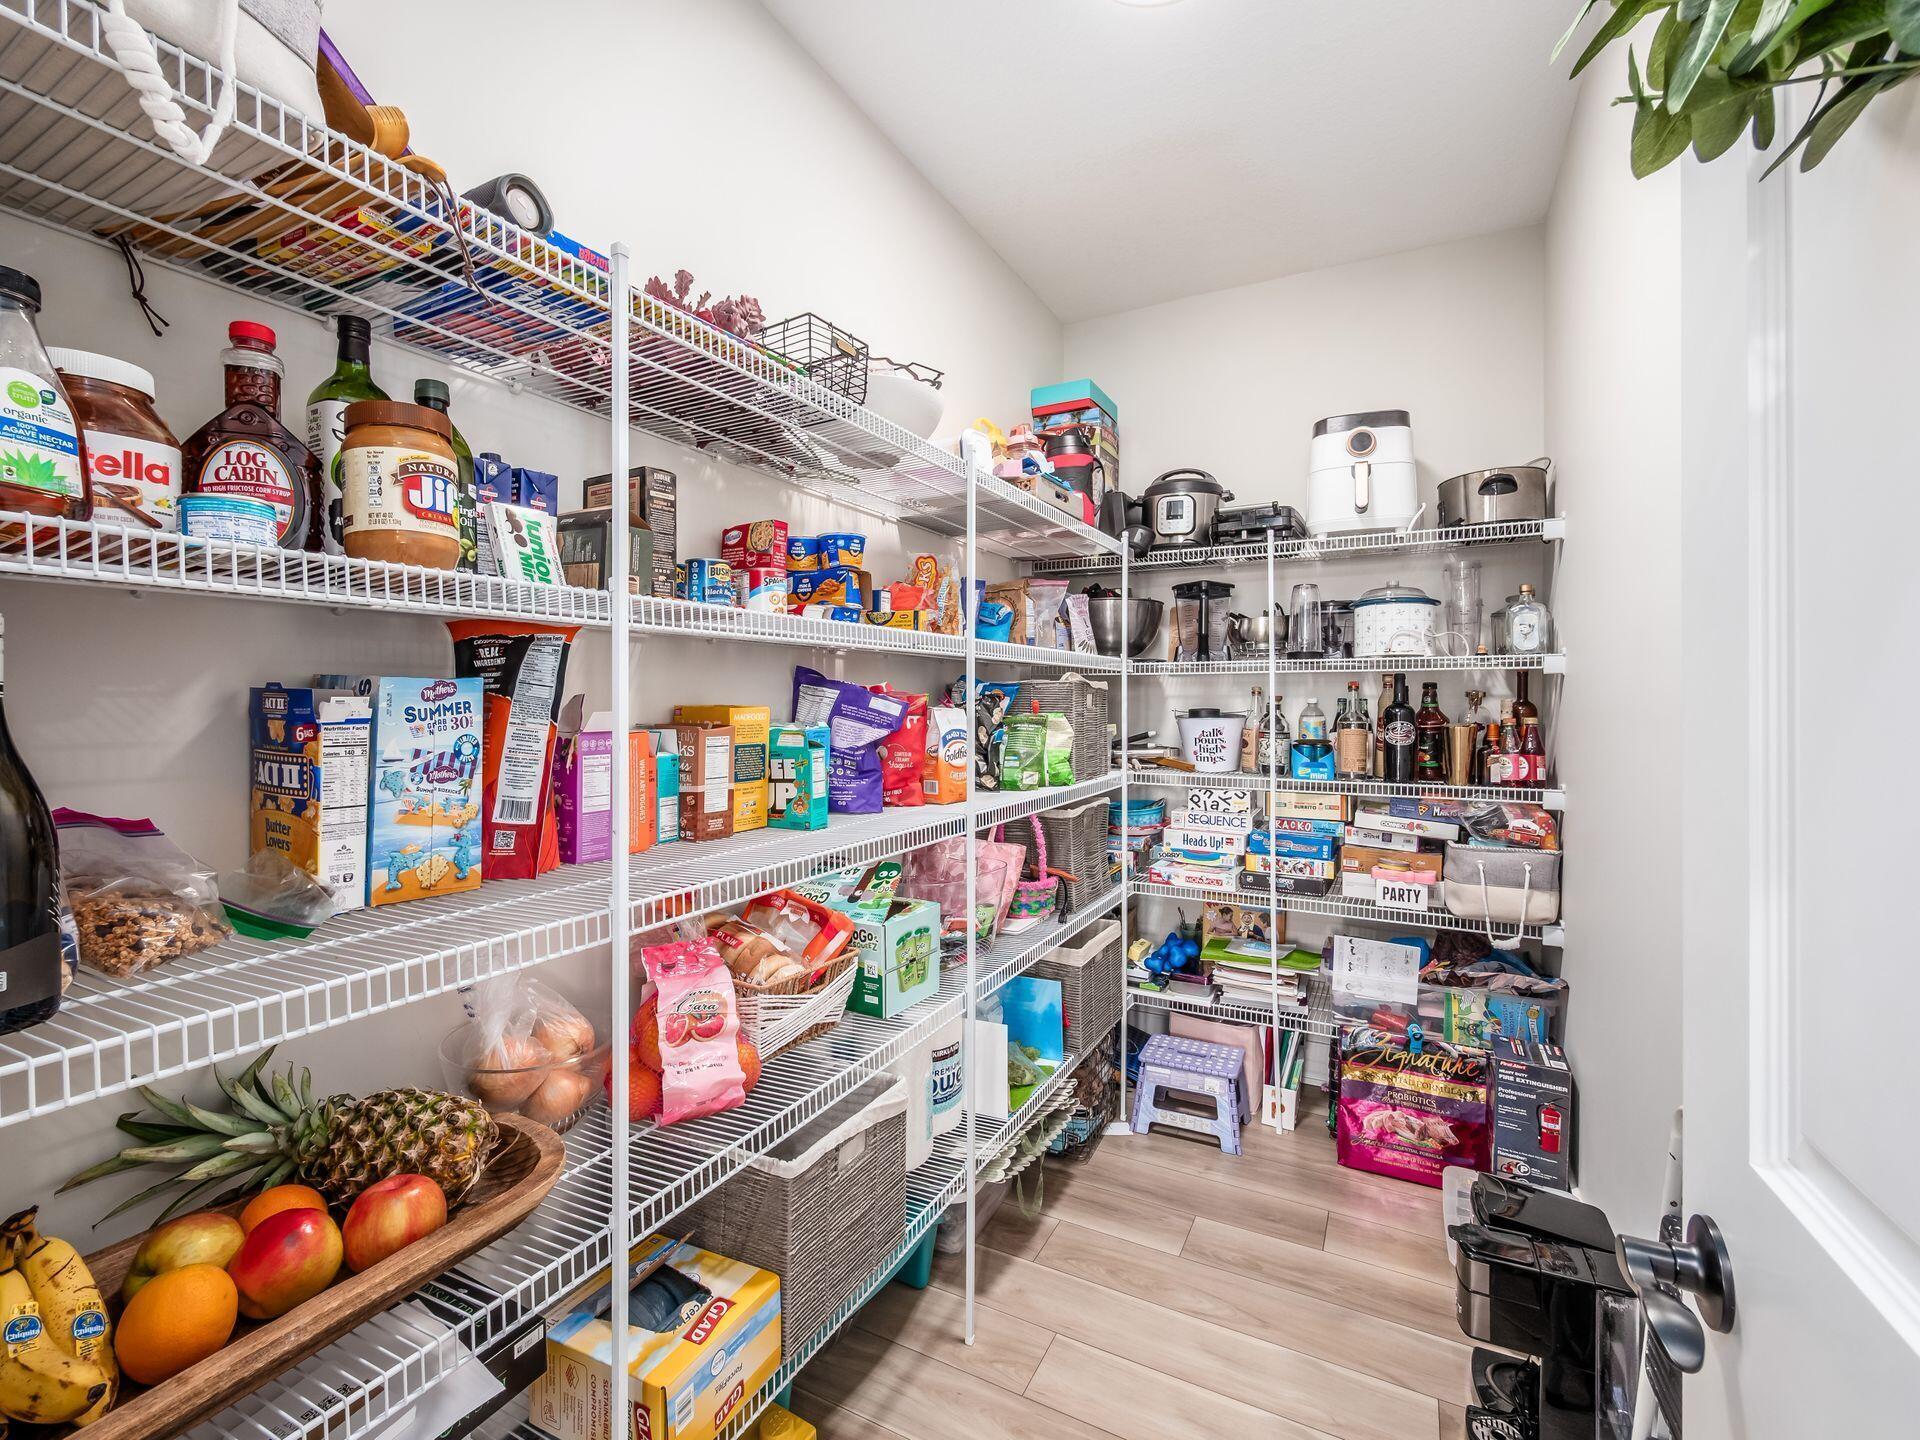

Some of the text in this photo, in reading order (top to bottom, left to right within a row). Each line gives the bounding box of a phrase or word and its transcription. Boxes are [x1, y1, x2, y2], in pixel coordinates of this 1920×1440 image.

[3, 407, 48, 424] organic
[2, 424, 38, 439] AGAVE
[39, 434, 74, 449] NECTAR
[224, 450, 267, 468] LOG
[214, 465, 279, 485] CABIN
[227, 484, 255, 493] FRUCTOSE
[256, 486, 271, 494] CORN
[272, 488, 291, 498] SYRUP
[409, 475, 458, 515] Jif
[460, 517, 473, 527] Oil
[524, 519, 552, 585] Junior
[479, 647, 499, 658] REAL
[404, 701, 472, 723] SUMMER
[451, 716, 470, 731] 30
[295, 727, 304, 741] 6
[1201, 728, 1219, 737] tall
[1199, 744, 1223, 755] high
[257, 762, 301, 789] ACT II
[1310, 772, 1328, 780] mini
[265, 818, 292, 836] Butter
[1188, 813, 1247, 828] SEQUENCE
[265, 832, 291, 851] Lovers
[1183, 834, 1224, 850] Heads Up!
[1382, 886, 1421, 904] PARTY
[716, 931, 738, 947] PLAIN
[677, 996, 720, 1015] Cara
[1498, 1074, 1569, 1093] FIRE EXTINGUISHER
[1387, 1090, 1436, 1107] PROBIOTICS
[1498, 1086, 1537, 1099] Professional
[1498, 1092, 1517, 1101] Grade
[690, 1300, 729, 1343] GLAD
[6, 1329, 40, 1341] Chiquita
[74, 1326, 105, 1336] Chiquita
[716, 1385, 742, 1425] GLAD
